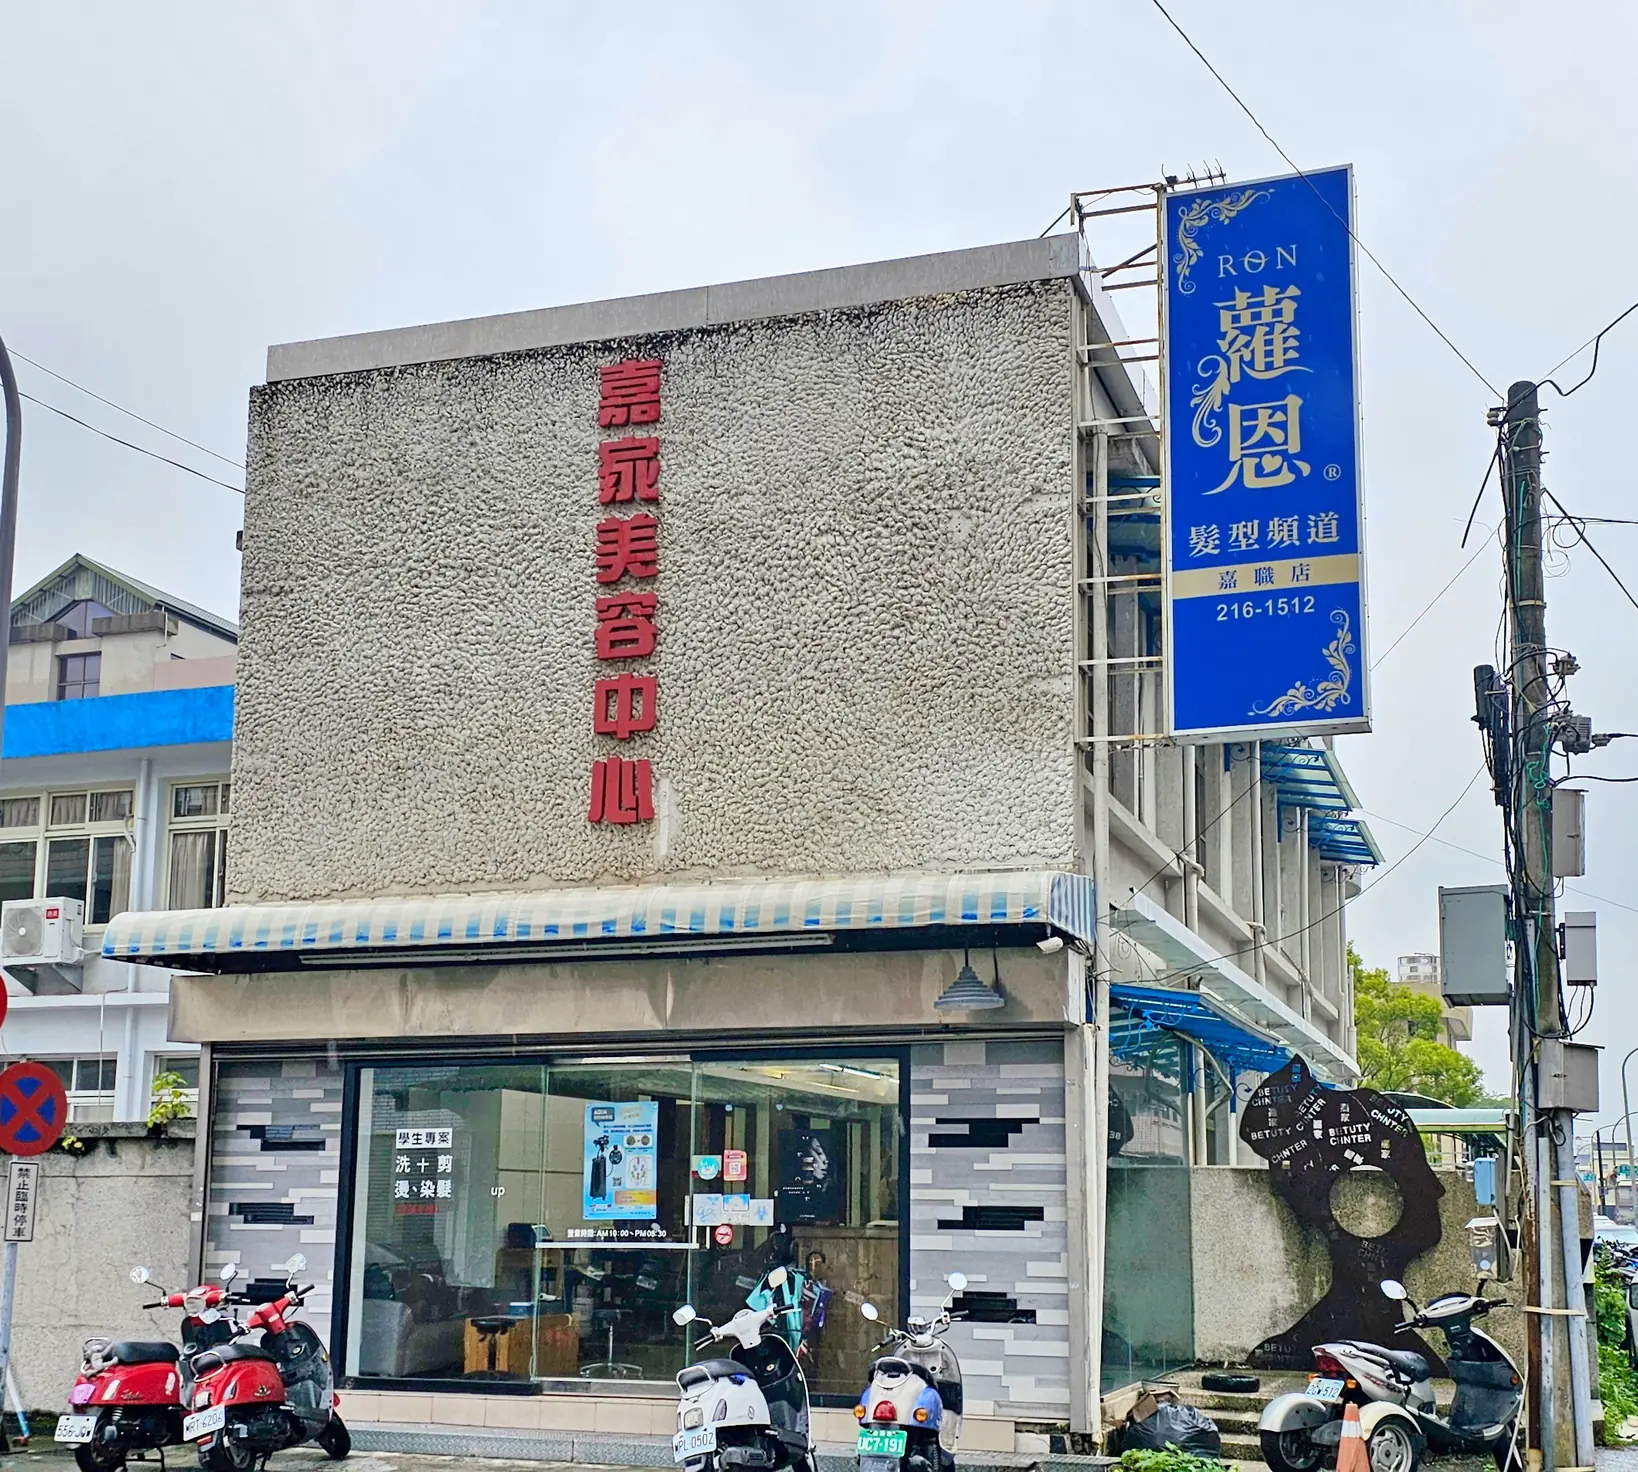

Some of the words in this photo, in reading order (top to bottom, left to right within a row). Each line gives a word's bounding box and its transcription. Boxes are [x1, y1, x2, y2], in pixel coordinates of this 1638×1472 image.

[1217, 244, 1298, 278] RON
[1188, 511, 1340, 557] 髮型頻道
[1217, 562, 1310, 591] 嘉職店
[1216, 595, 1316, 621] 216-1512
[398, 1131, 450, 1145] 學生專案
[1250, 1127, 1292, 1141] BETUTY
[1271, 1139, 1308, 1164] CHNTER
[12, 1167, 32, 1238] 禁止臨時停車
[490, 1186, 506, 1198] up
[857, 1436, 904, 1453] UC7-191
